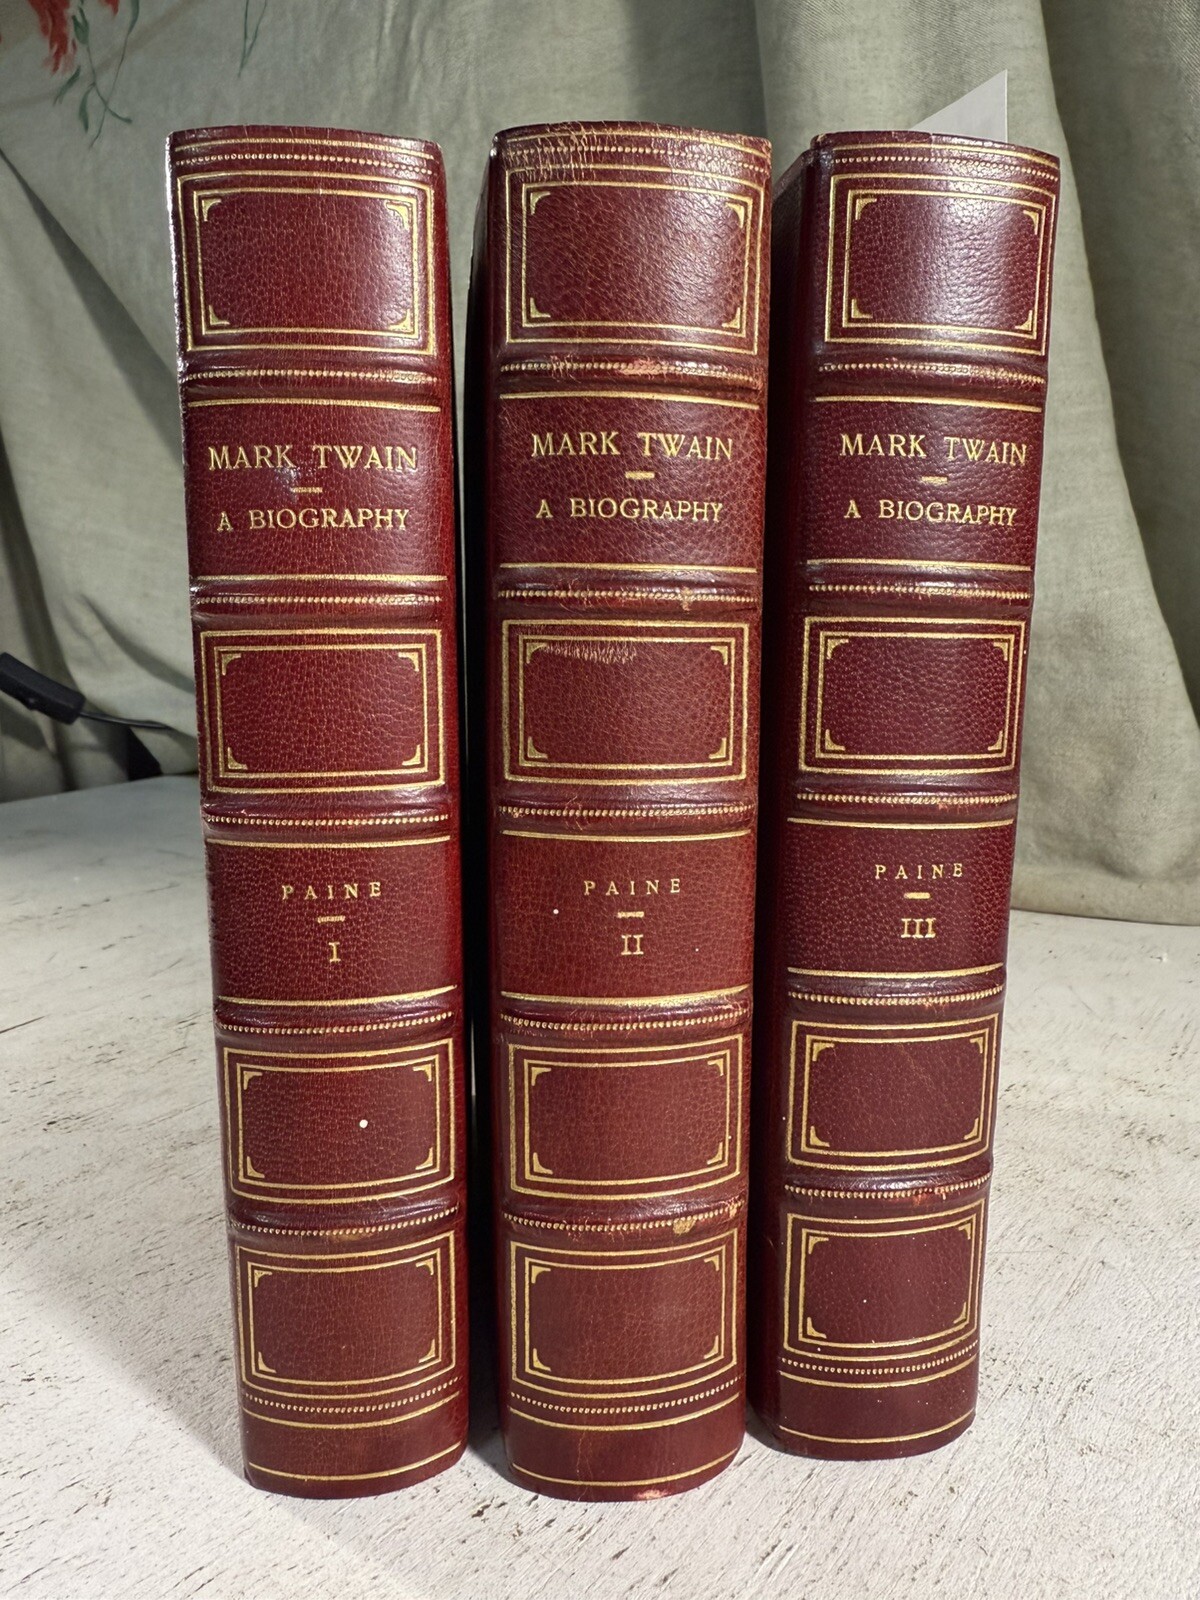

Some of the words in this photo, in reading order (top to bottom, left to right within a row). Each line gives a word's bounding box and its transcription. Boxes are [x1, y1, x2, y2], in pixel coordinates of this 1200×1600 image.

[208, 444, 297, 471] MARK
[312, 444, 418, 471] TWAIN
[531, 431, 621, 458] MARK
[637, 432, 733, 461] TWAIN
[839, 433, 927, 459] MARK
[943, 436, 1027, 466] TWAIN
[216, 511, 234, 532] A
[249, 508, 410, 531] BIOGRAPHY
[535, 499, 554, 519] A
[569, 497, 724, 523] BIOGRAPHY
[843, 499, 861, 519] A
[878, 499, 1018, 527] BIOGRAPHY
[874, 862, 963, 880] PAINE
[281, 881, 382, 901] PAINE
[583, 878, 681, 896] PAINE
[900, 917, 937, 939] III
[328, 941, 341, 963] I
[620, 934, 645, 956] II
